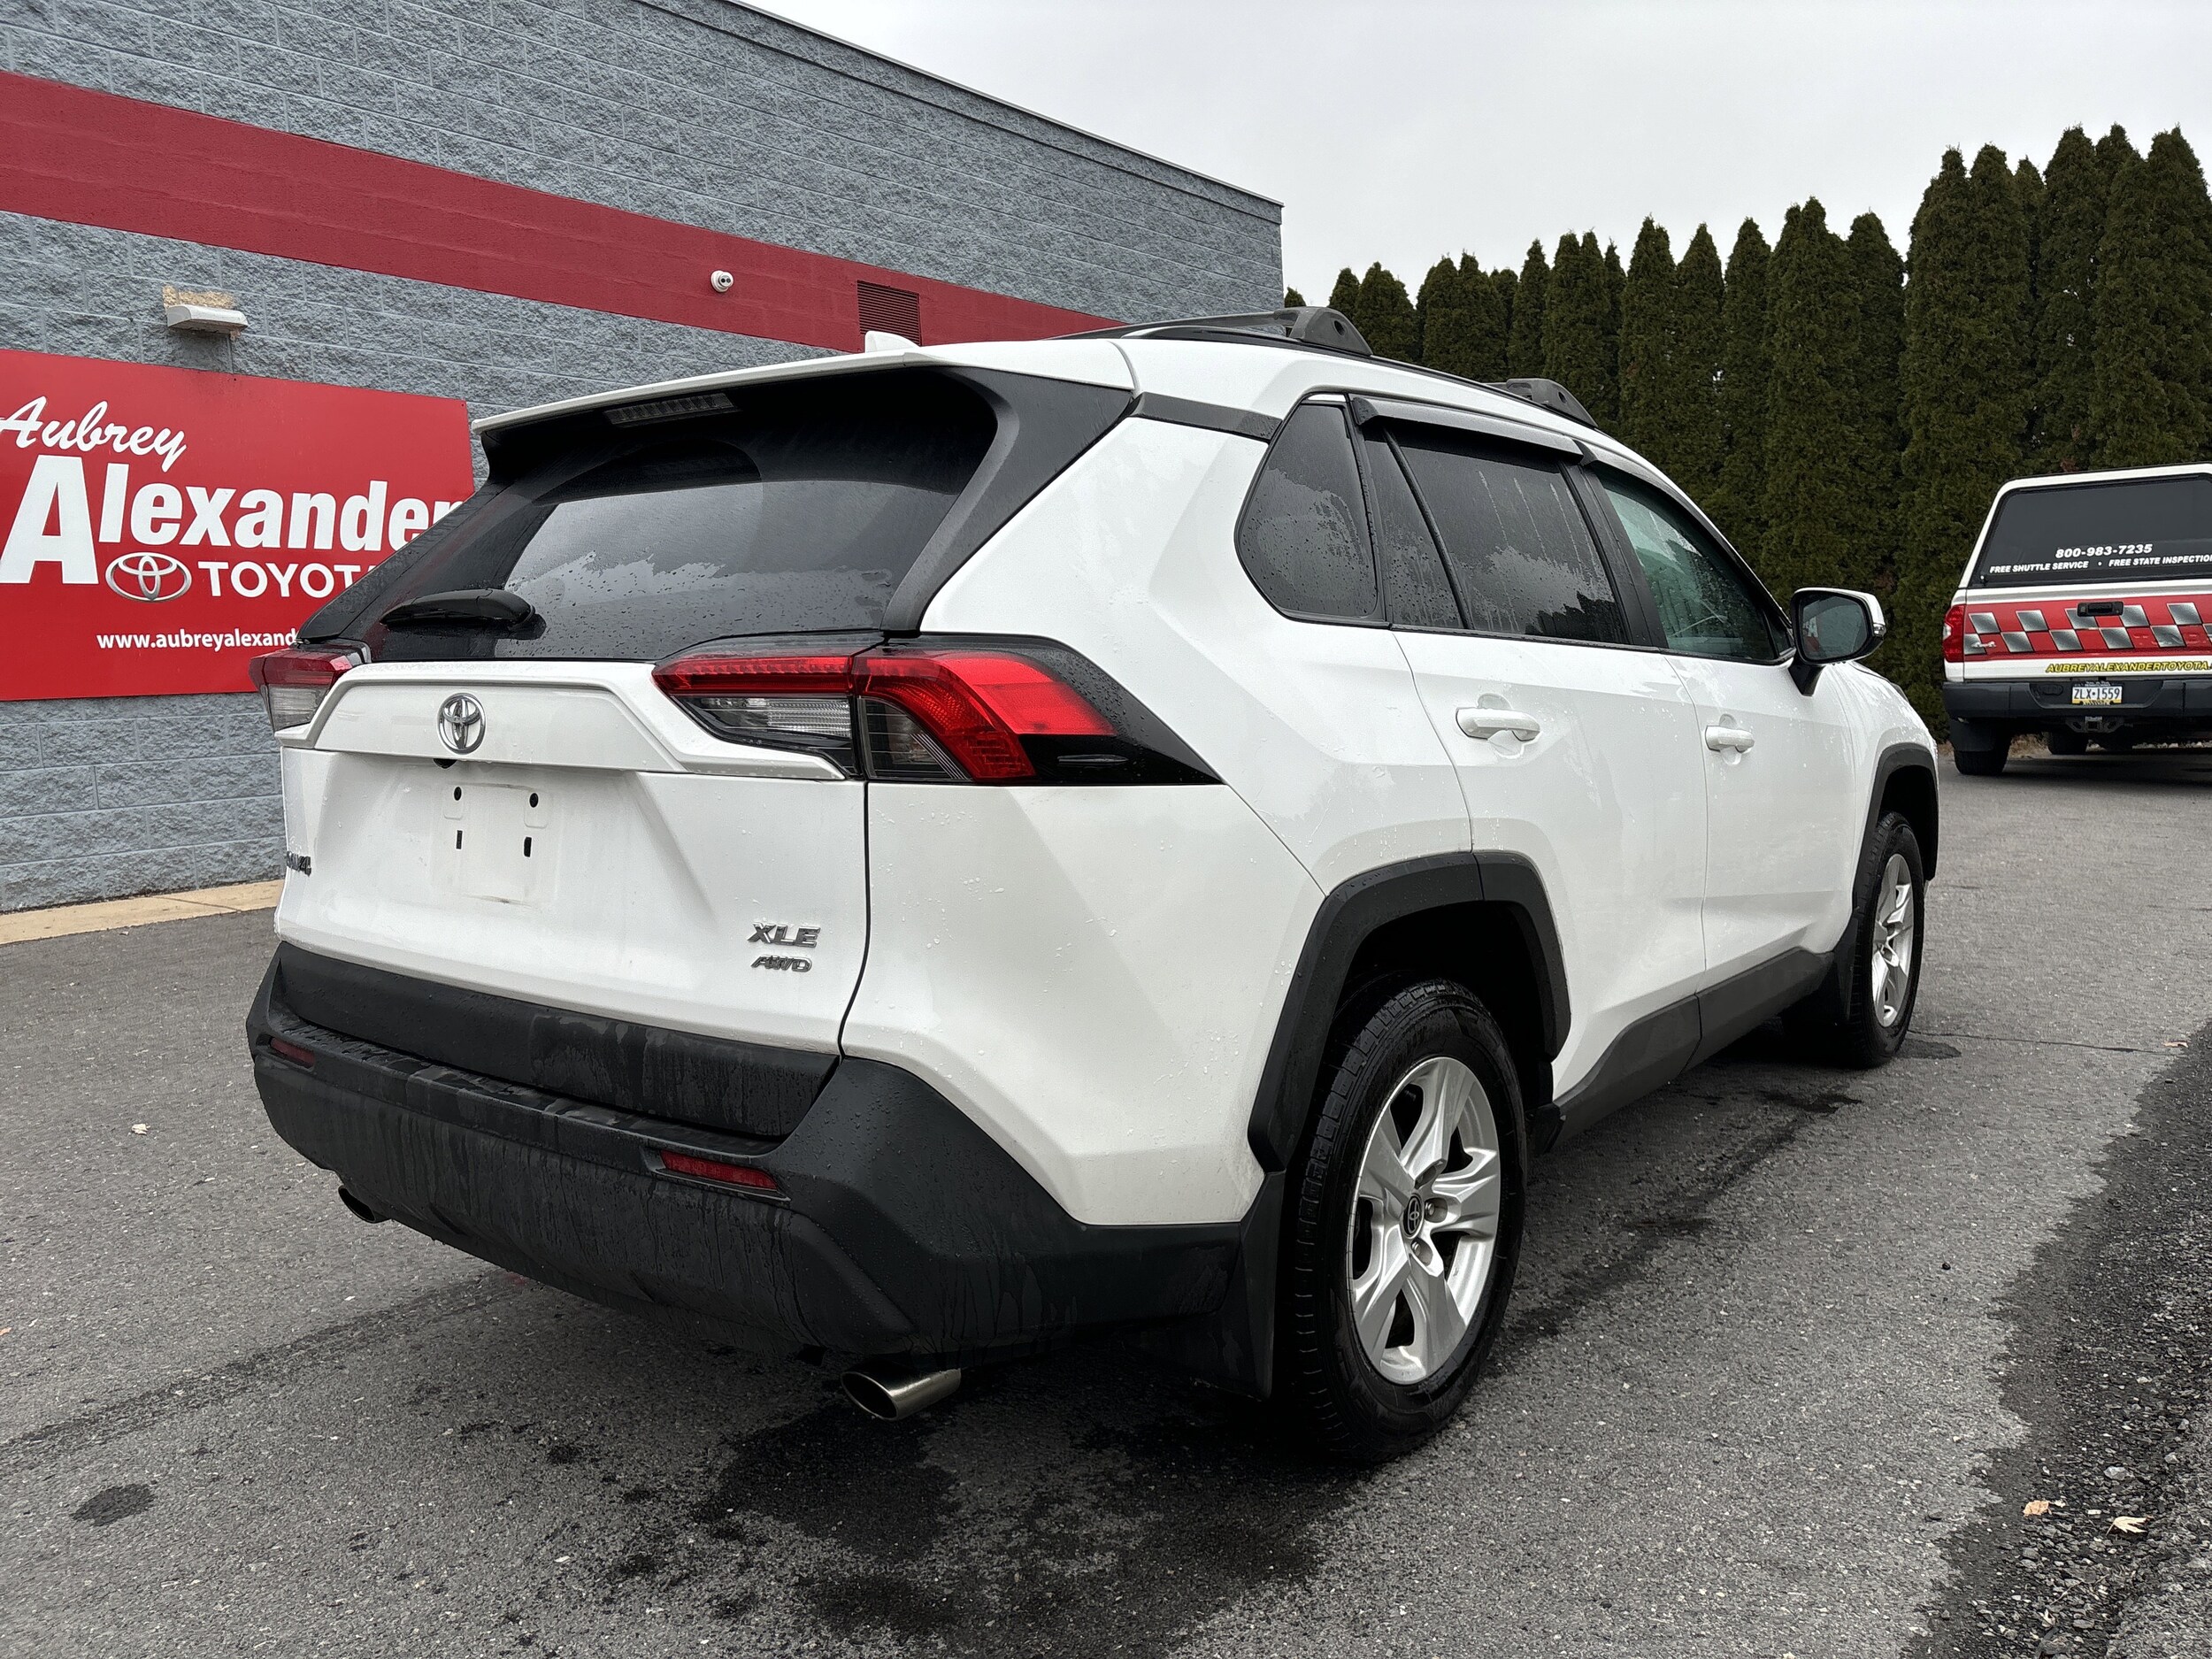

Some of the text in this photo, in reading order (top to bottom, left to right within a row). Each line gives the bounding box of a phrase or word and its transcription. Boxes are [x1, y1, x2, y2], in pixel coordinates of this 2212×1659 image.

[0, 396, 187, 472] Aubrey
[2055, 544, 2153, 558] 800-983-7235
[2012, 563, 2051, 572] SHUTTLE
[2052, 561, 2089, 571] SERVICE
[2132, 557, 2161, 565] STATE
[2162, 554, 2212, 564] INSPECTIO
[198, 561, 376, 598] TOYOT
[2046, 662, 2212, 673] AUBREYALEXANDERTOYOTA.
[747, 922, 821, 948] XLE
[750, 954, 812, 972] AWD
